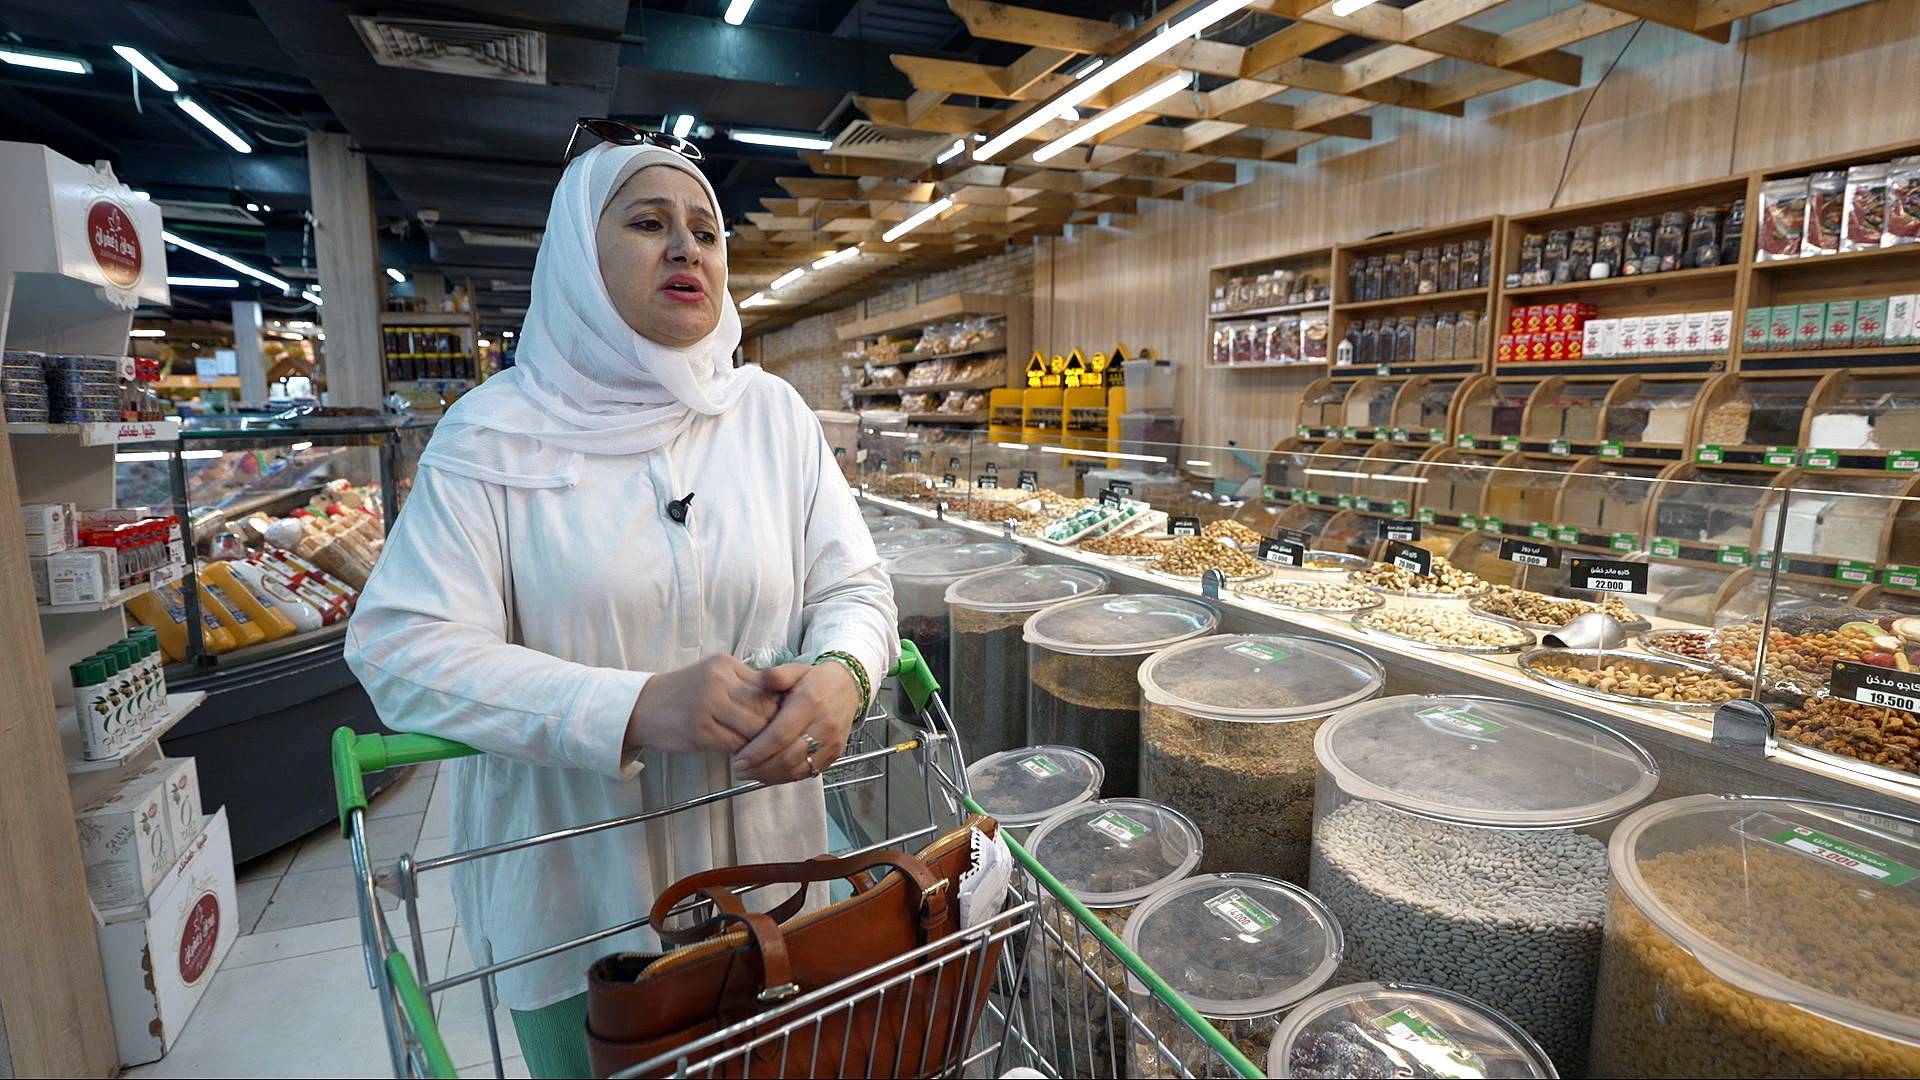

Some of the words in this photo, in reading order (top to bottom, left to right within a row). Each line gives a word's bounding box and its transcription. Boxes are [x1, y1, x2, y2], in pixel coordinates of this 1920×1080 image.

[1590, 566, 1604, 575] خشن
[1604, 567, 1617, 576] مالح
[1617, 567, 1630, 577] كاجو
[1595, 579, 1624, 590] 22.000
[1865, 674, 1894, 687] مدخن
[1870, 692, 1914, 710] 19.500
[1811, 848, 1861, 867] 3.000
